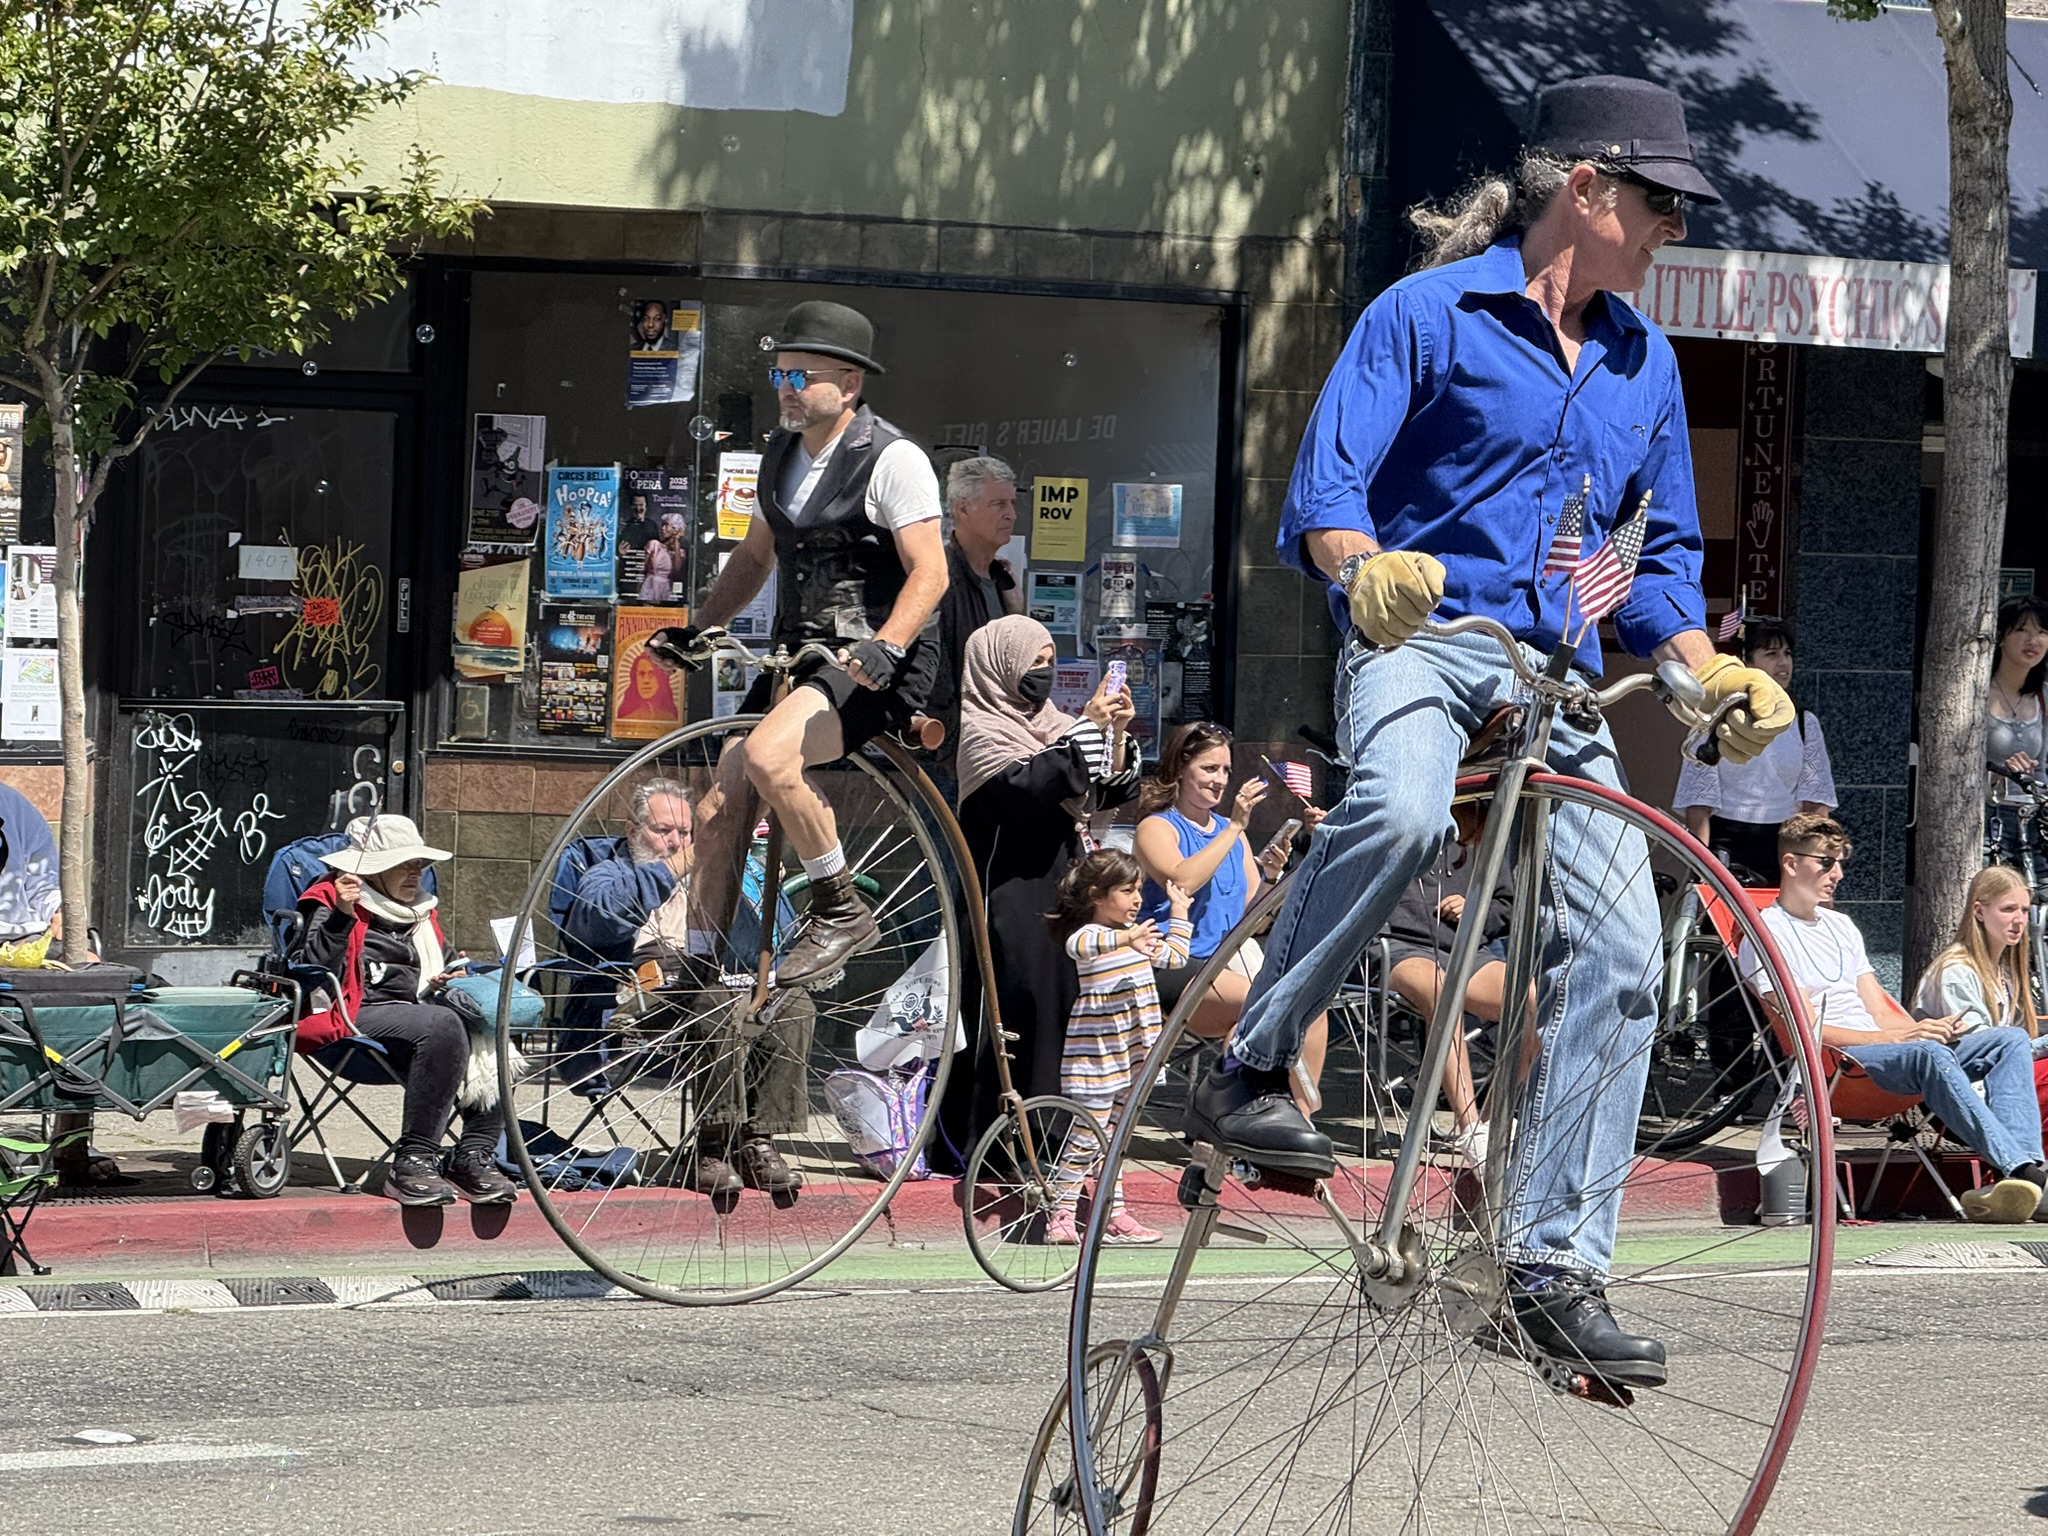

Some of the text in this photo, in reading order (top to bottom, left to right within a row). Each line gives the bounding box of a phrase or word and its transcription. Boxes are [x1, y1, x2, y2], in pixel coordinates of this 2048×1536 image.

[1763, 271, 1914, 343] PSYCHIC
[630, 480, 662, 490] OPERA
[1040, 485, 1079, 503] IMP
[1039, 507, 1073, 520] ROV
[400, 583, 410, 620] PULL
[147, 873, 215, 930] Jody
